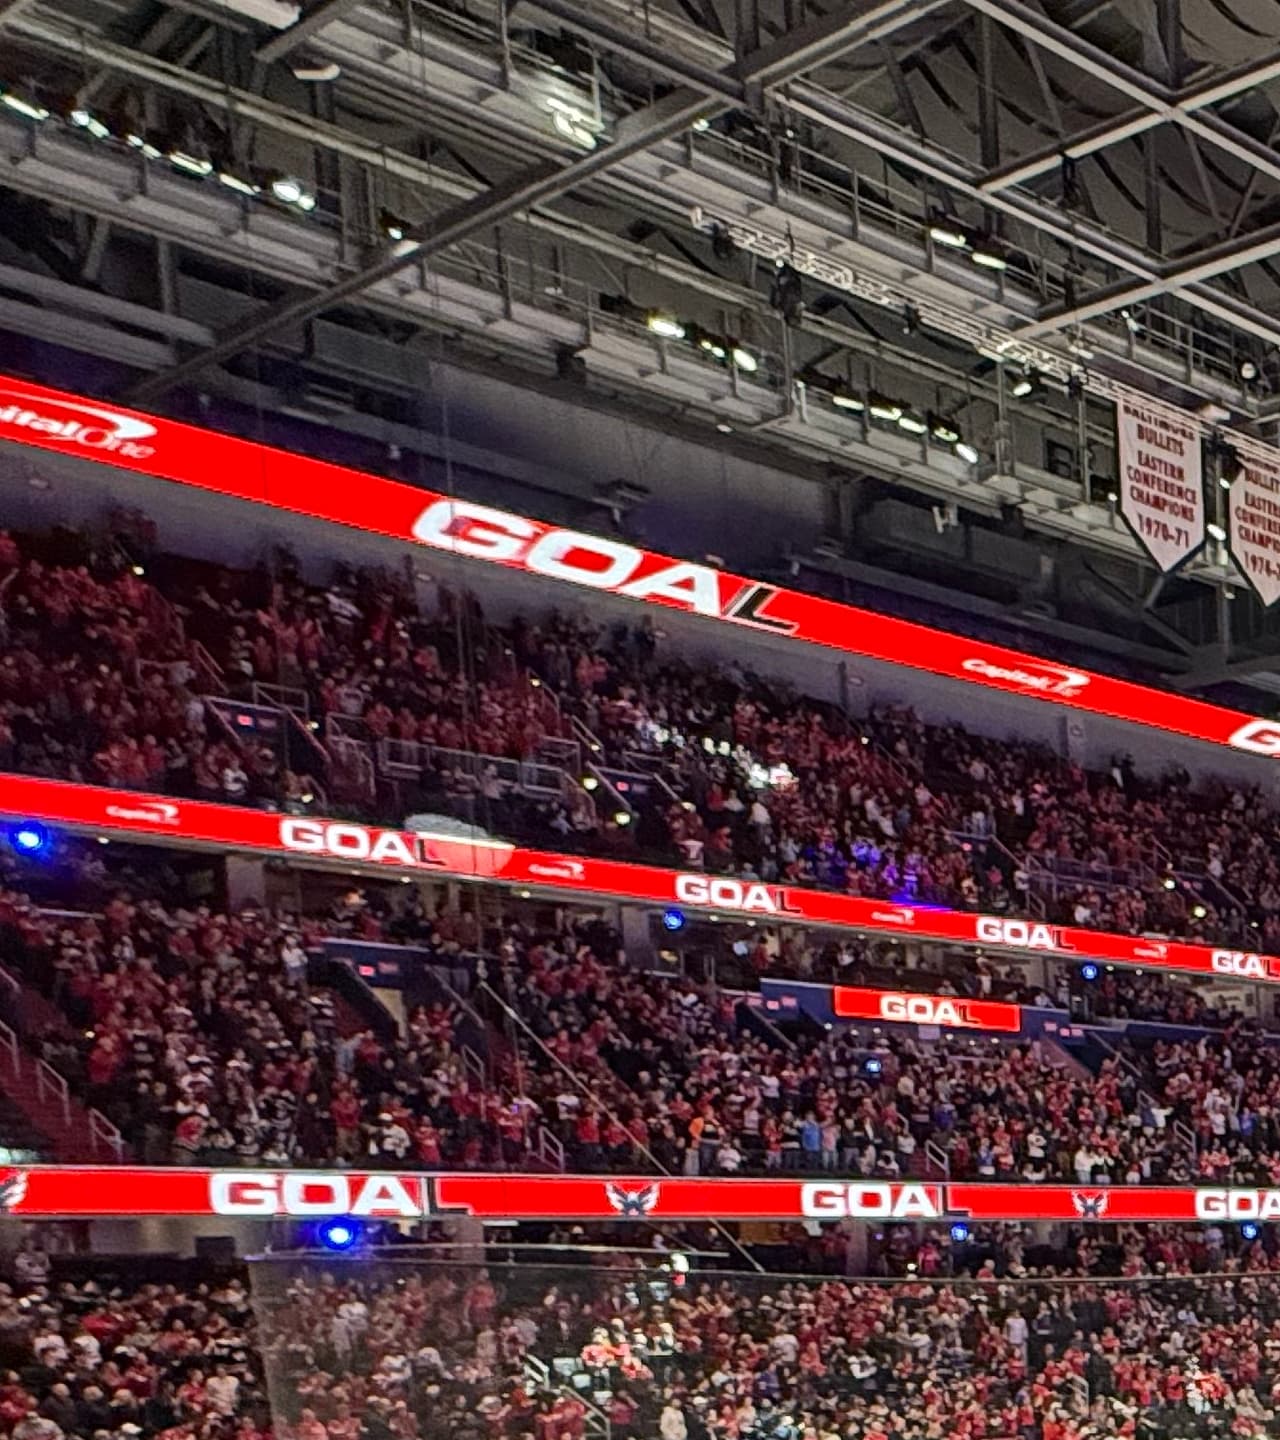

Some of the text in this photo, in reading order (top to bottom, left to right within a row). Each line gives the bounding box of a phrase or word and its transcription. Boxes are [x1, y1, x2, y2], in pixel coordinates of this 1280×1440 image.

[1137, 424, 1184, 457] BULLETS
[1138, 451, 1185, 482] EASTERN
[1126, 465, 1197, 505] CONFERENCE
[1130, 485, 1195, 522] CHAMPIONS
[1138, 513, 1190, 549] 1970-71
[411, 498, 800, 635] GOAL
[280, 819, 447, 867] GOAL
[676, 874, 803, 914] GOAL
[976, 917, 1077, 951] GOAL
[880, 996, 979, 1026] GOAL
[208, 1172, 475, 1217] GOAL
[800, 1182, 973, 1218] GOAL
